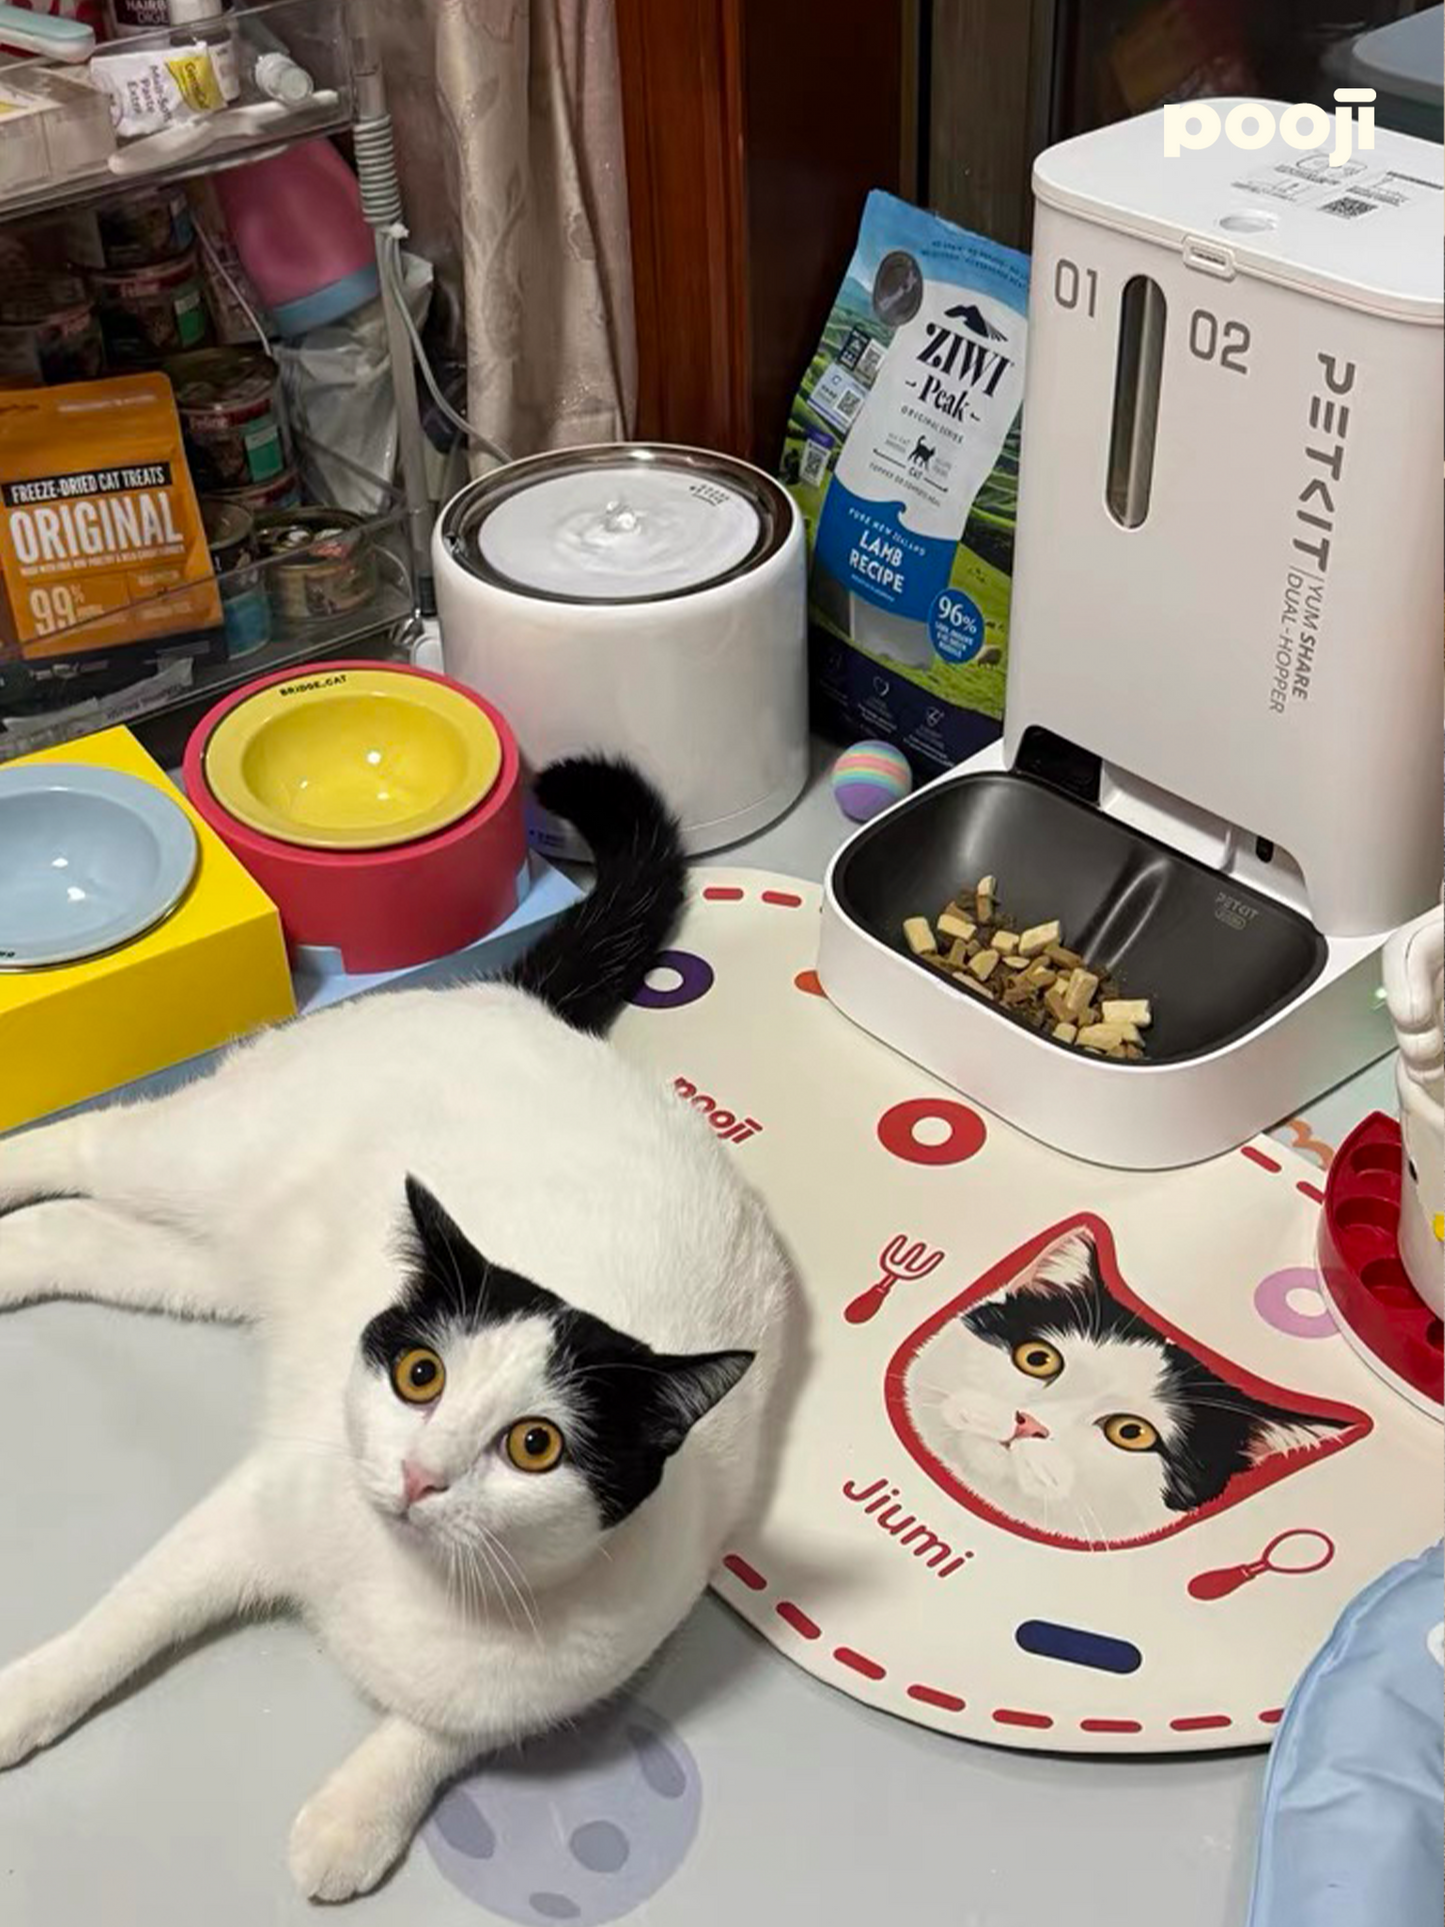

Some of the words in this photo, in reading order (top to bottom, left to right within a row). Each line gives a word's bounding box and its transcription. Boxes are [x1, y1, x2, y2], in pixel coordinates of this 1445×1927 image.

[127, 81, 143, 115] Extra
[1055, 258, 1098, 318] 01
[917, 322, 1013, 398] ZIWI
[1189, 309, 1251, 375] 02
[919, 374, 971, 422] Peak
[10, 475, 98, 503] FREEZE-DRIED
[99, 472, 121, 491] CAT
[122, 466, 166, 486] TREATS
[1293, 352, 1355, 572] PETKIT
[9, 491, 184, 565] ORIGINAL
[859, 529, 904, 567] LAMB
[849, 548, 905, 594] RECIPE
[937, 595, 978, 635] 96%
[1302, 582, 1325, 631] YUM
[1292, 631, 1317, 700] SHARE
[842, 1478, 975, 1578] Jiumi
